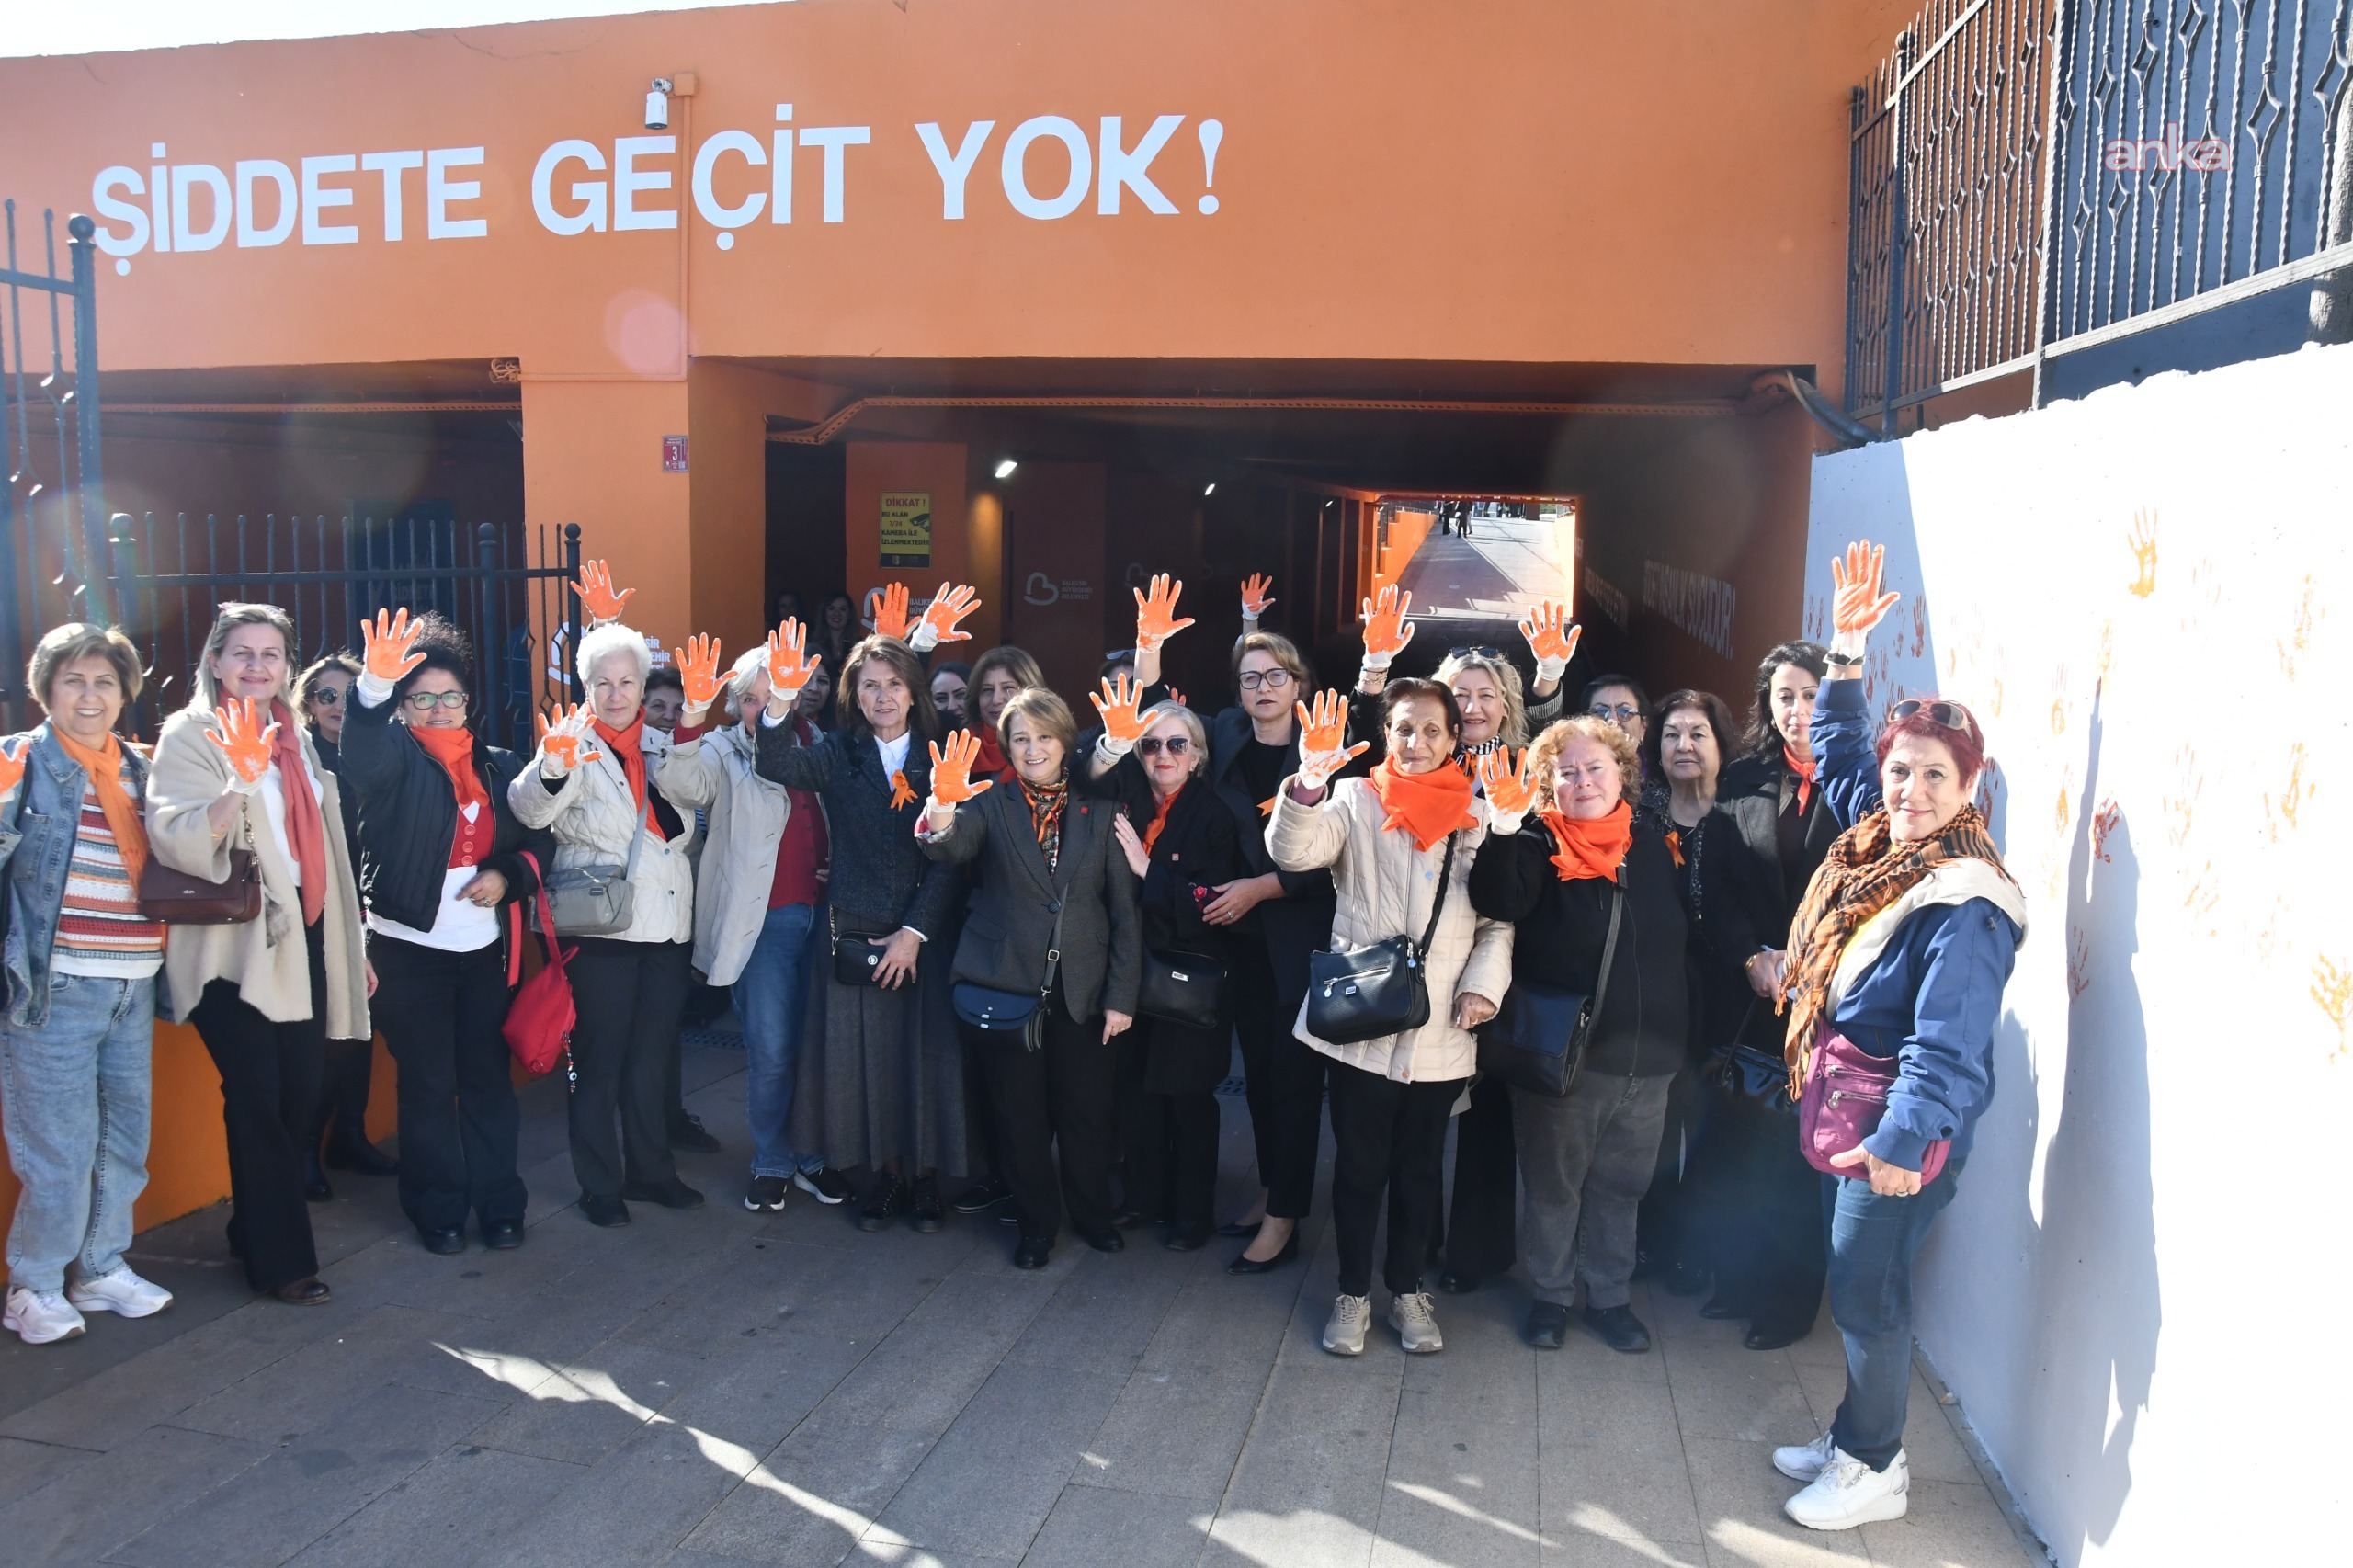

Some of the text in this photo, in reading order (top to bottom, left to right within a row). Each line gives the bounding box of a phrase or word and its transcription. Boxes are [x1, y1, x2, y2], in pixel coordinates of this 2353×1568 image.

[93, 104, 1223, 276] ŞİDDETE GEÇİT YOK!
[672, 446, 677, 460] 3
[886, 496, 920, 507] DİKKAT
